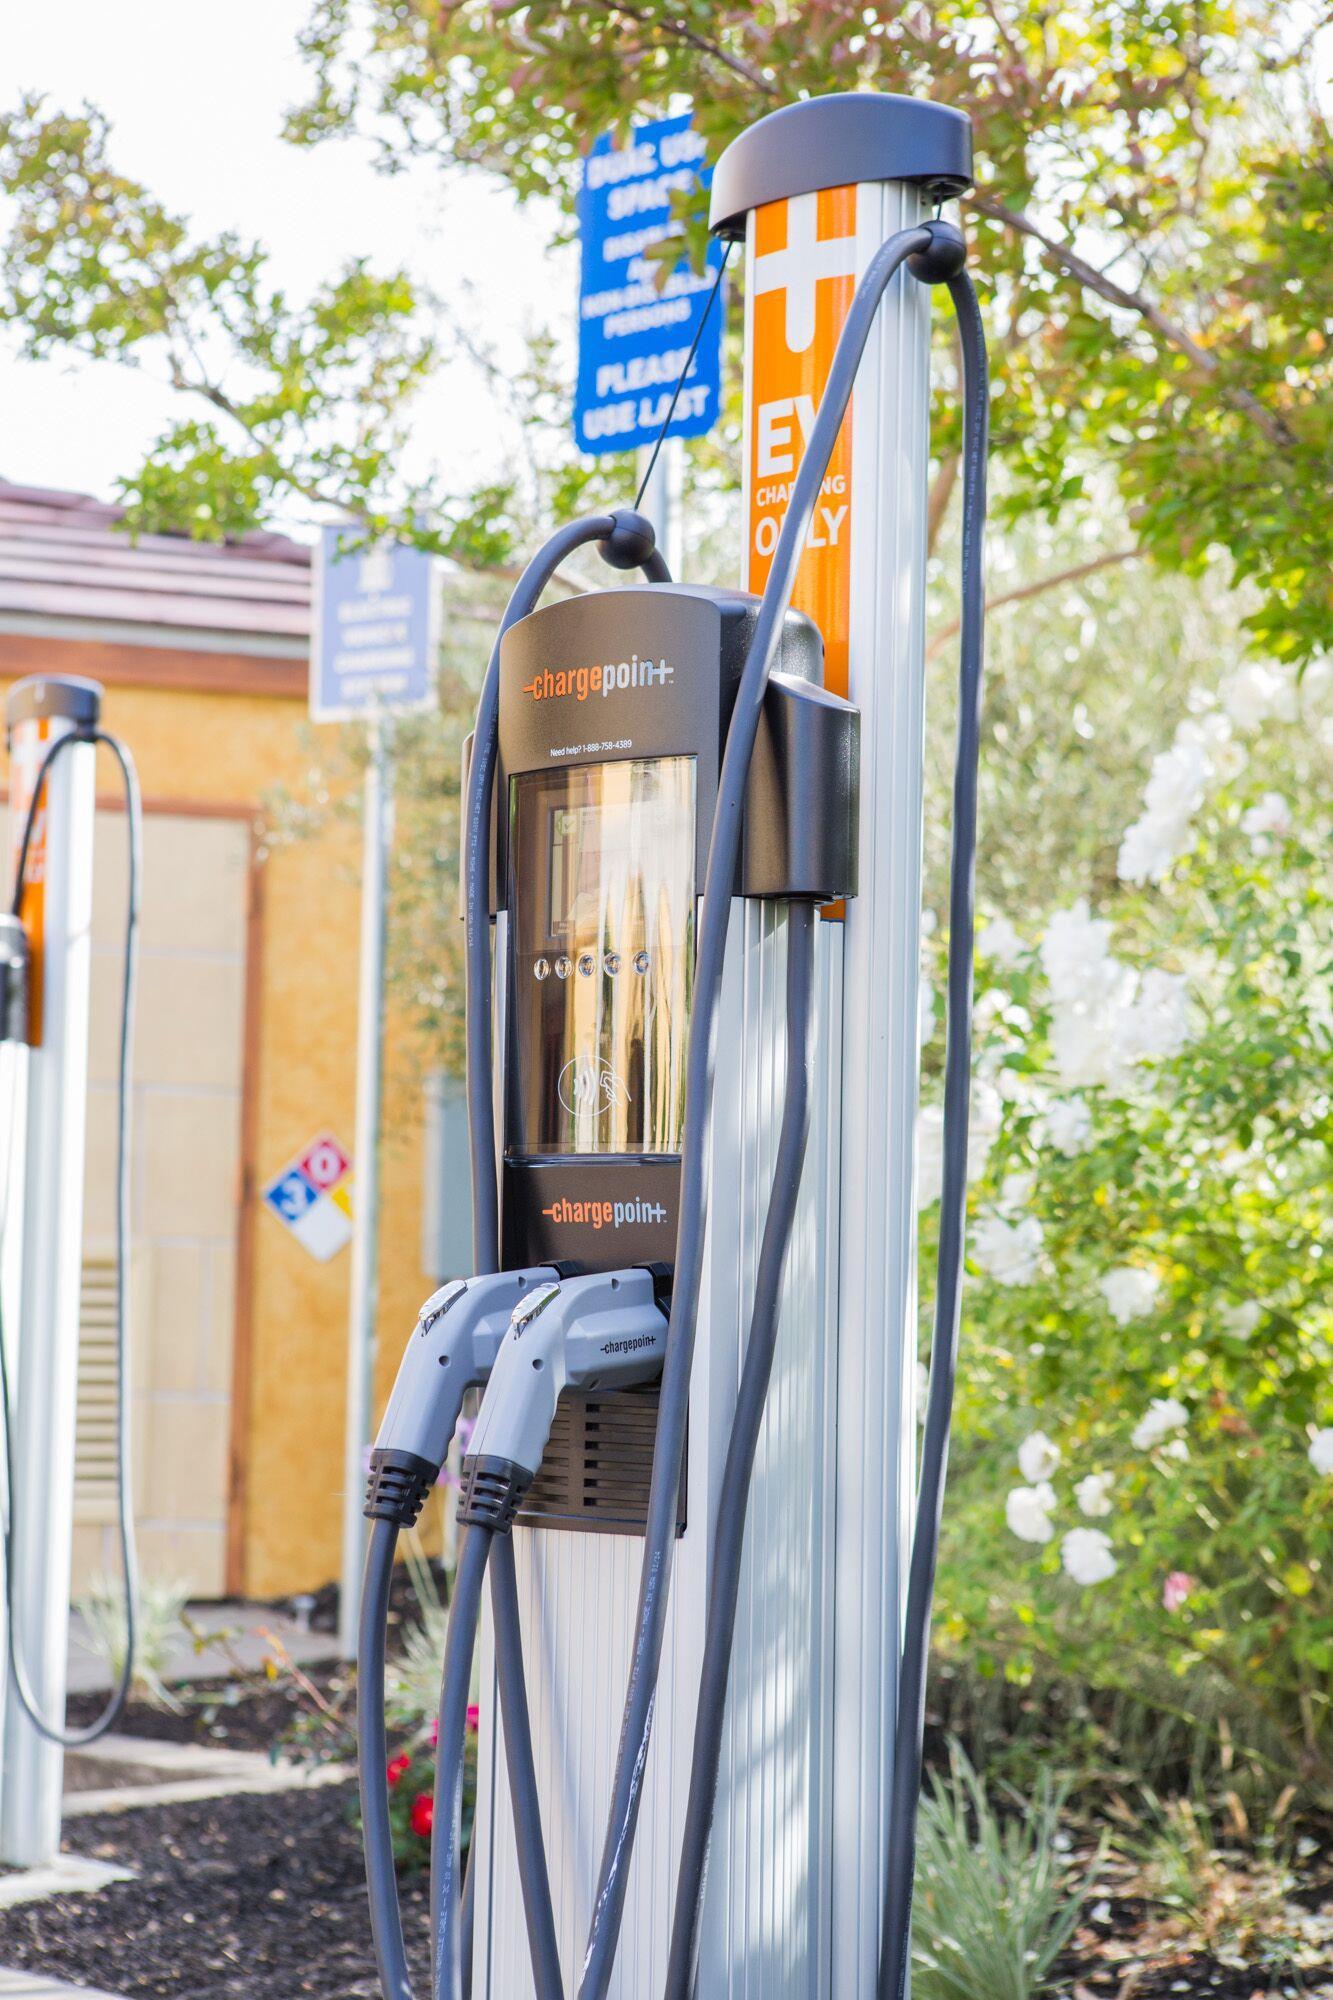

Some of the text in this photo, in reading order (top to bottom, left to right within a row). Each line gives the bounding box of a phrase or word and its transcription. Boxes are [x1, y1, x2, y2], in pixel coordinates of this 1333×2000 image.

[596, 346, 698, 398] PLEASE
[638, 385, 711, 428] LAST
[756, 475, 846, 507] CHANG
[756, 505, 848, 557] OLY
[550, 748, 566, 757] Need
[566, 746, 582, 755] help?
[310, 1147, 340, 1183] 0
[280, 1178, 307, 1214] 3
